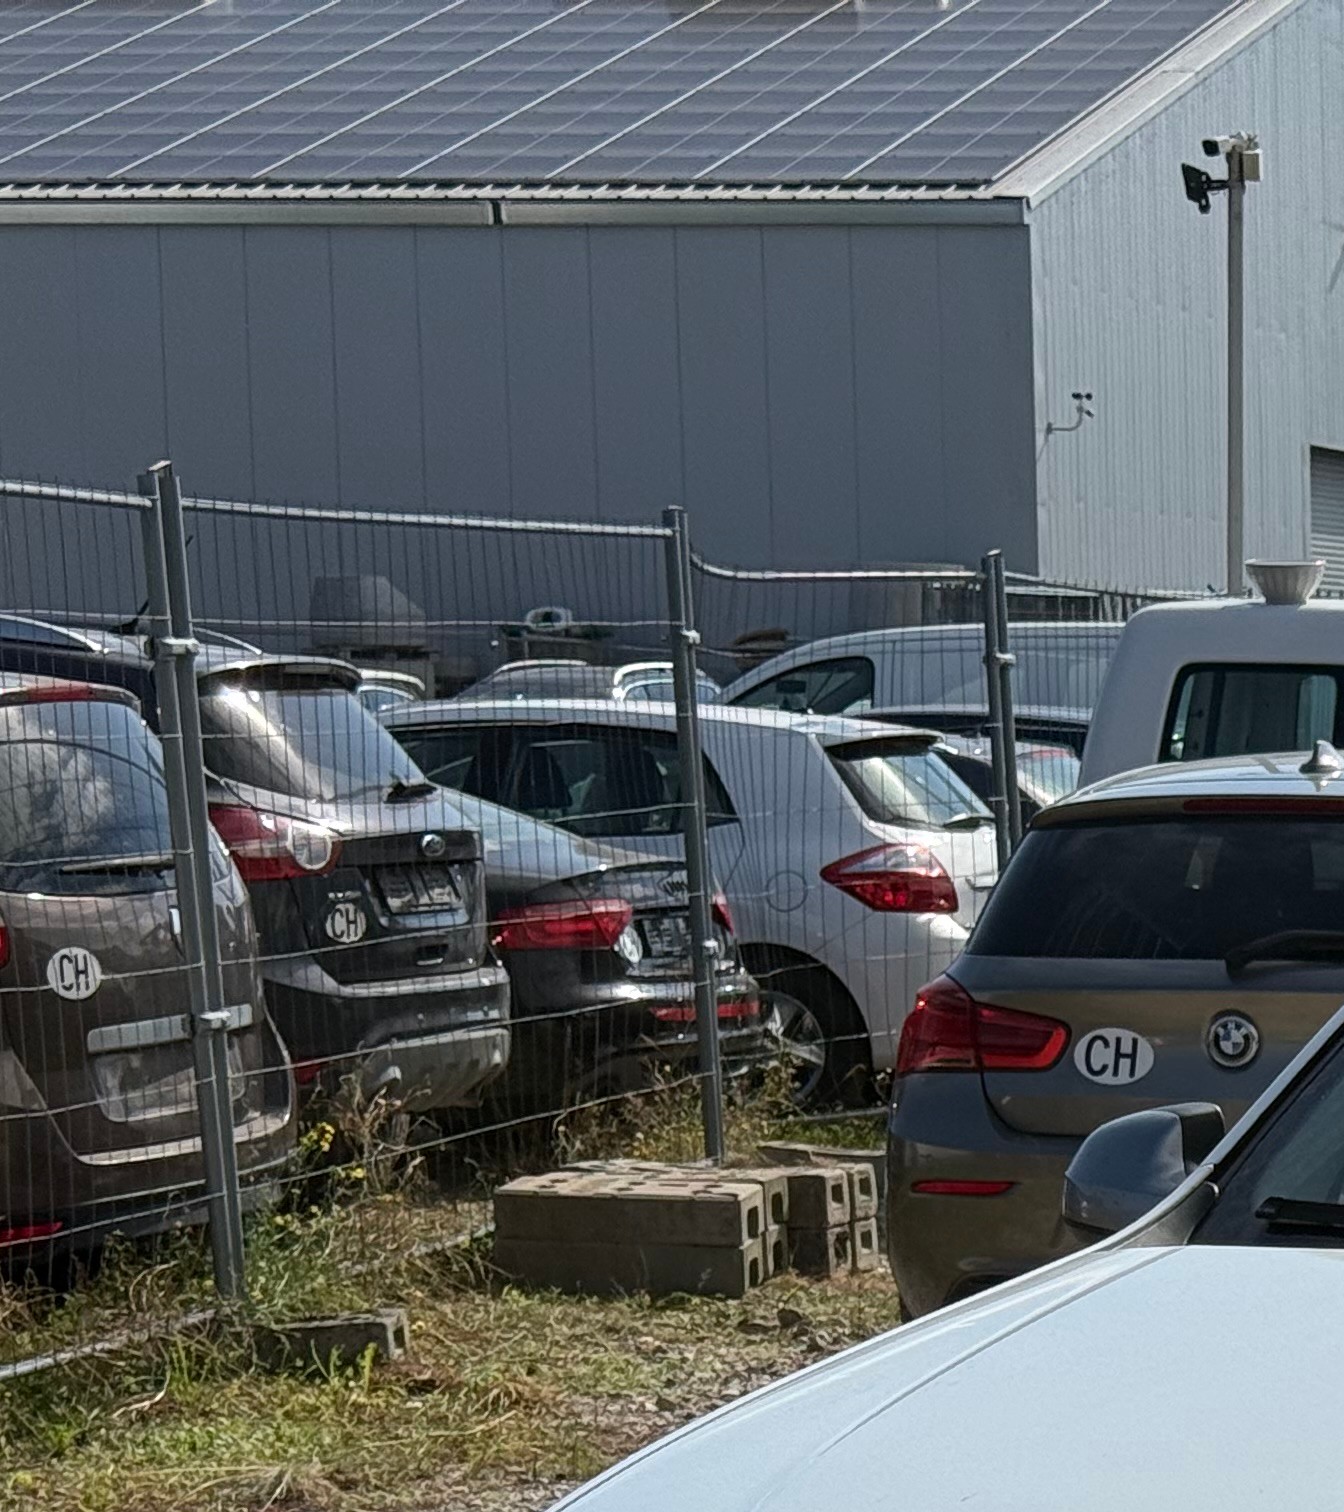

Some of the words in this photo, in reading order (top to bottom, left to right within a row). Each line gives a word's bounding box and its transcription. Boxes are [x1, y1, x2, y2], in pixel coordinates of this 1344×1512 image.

[331, 907, 359, 940] CH
[59, 953, 91, 992] CH
[1084, 1034, 1139, 1079] CH
